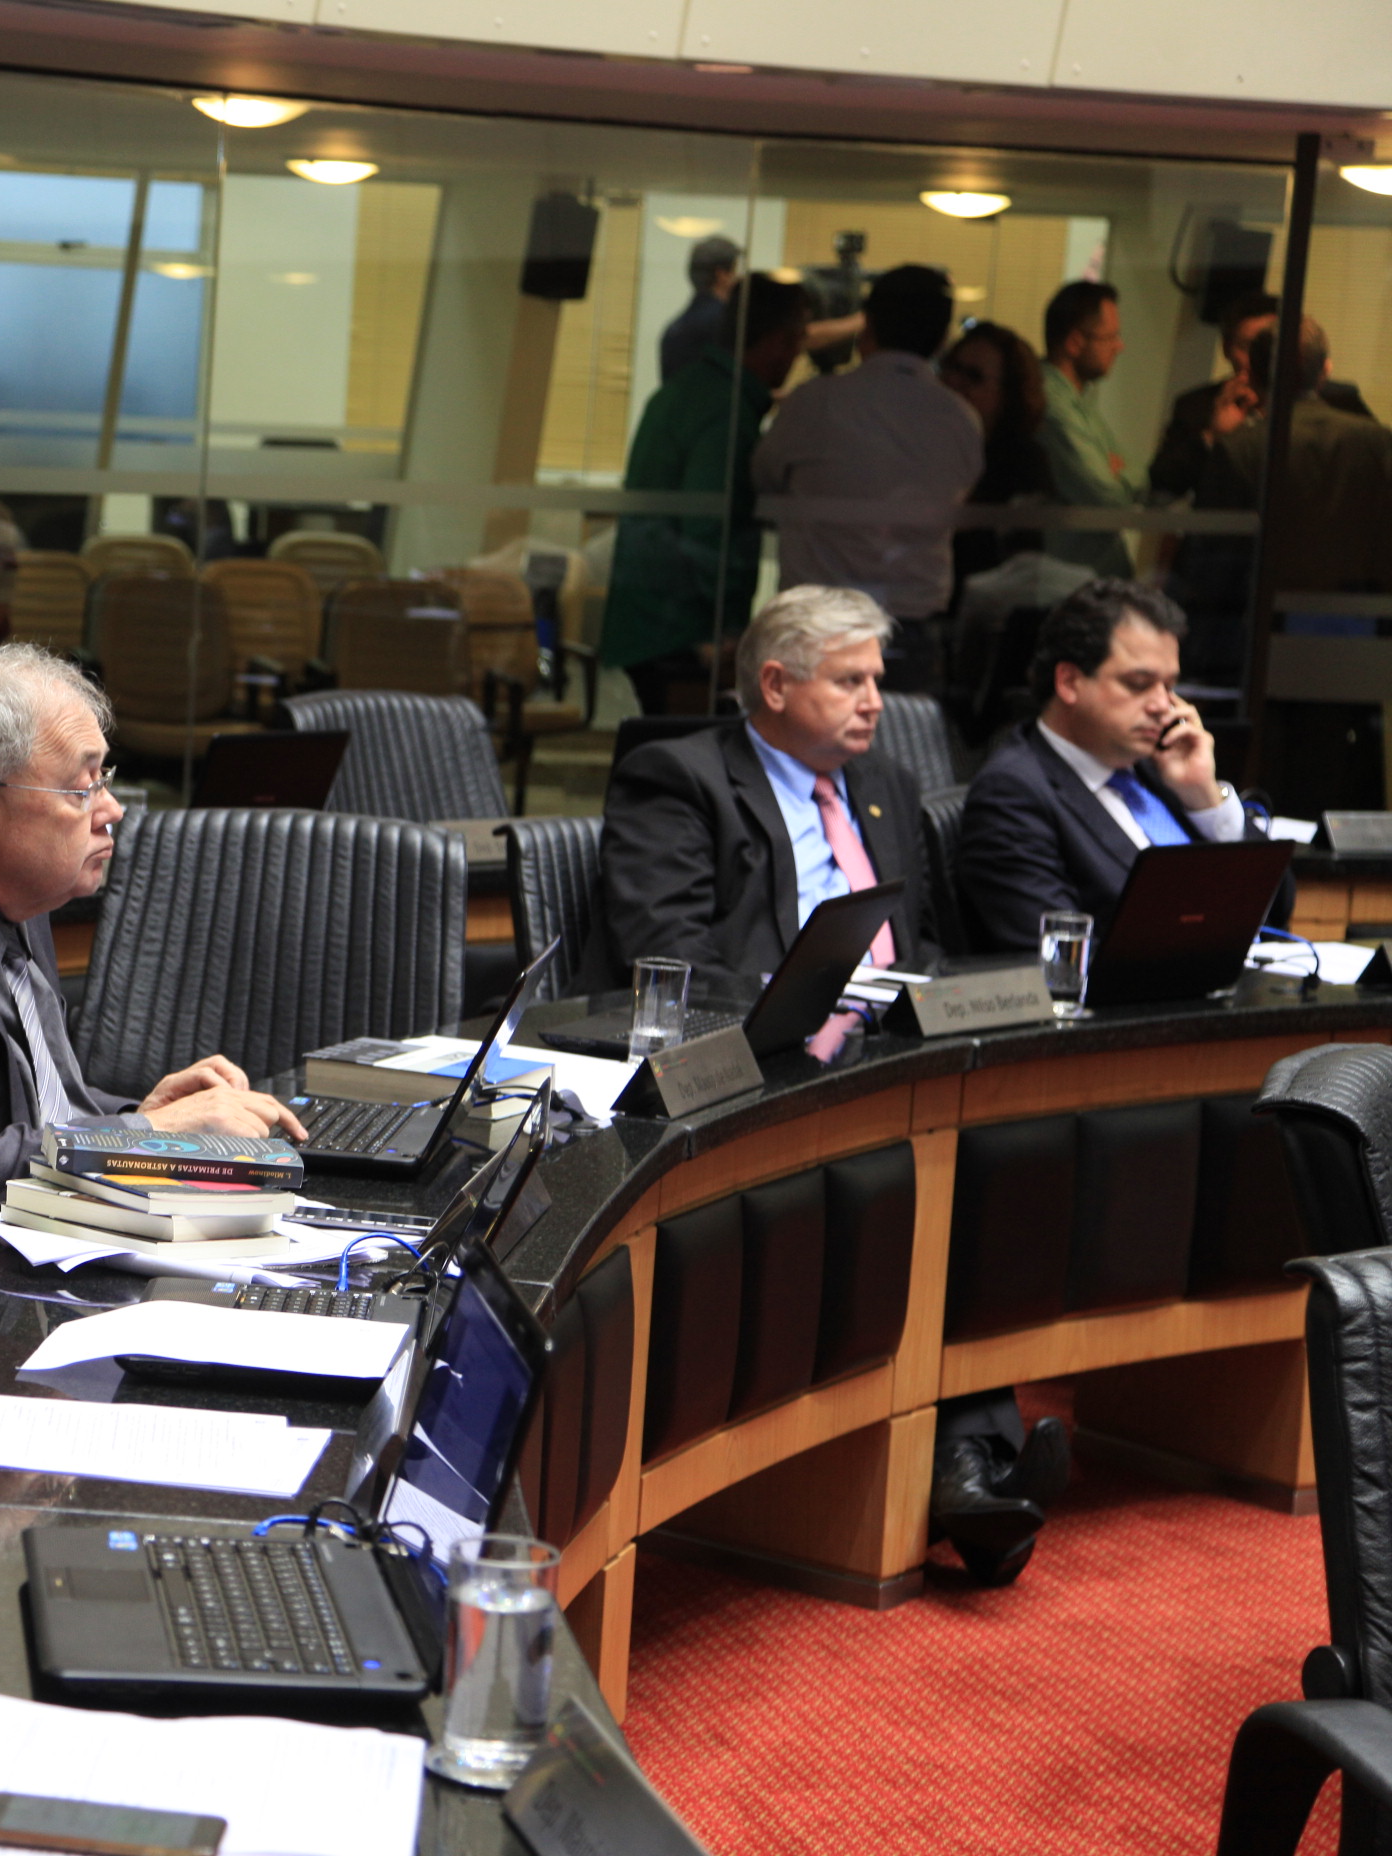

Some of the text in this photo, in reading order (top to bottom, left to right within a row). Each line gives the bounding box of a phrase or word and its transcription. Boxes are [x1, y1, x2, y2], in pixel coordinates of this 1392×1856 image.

[106, 1159, 233, 1176] DE PRIMATAS A ASTRONAUTAS
